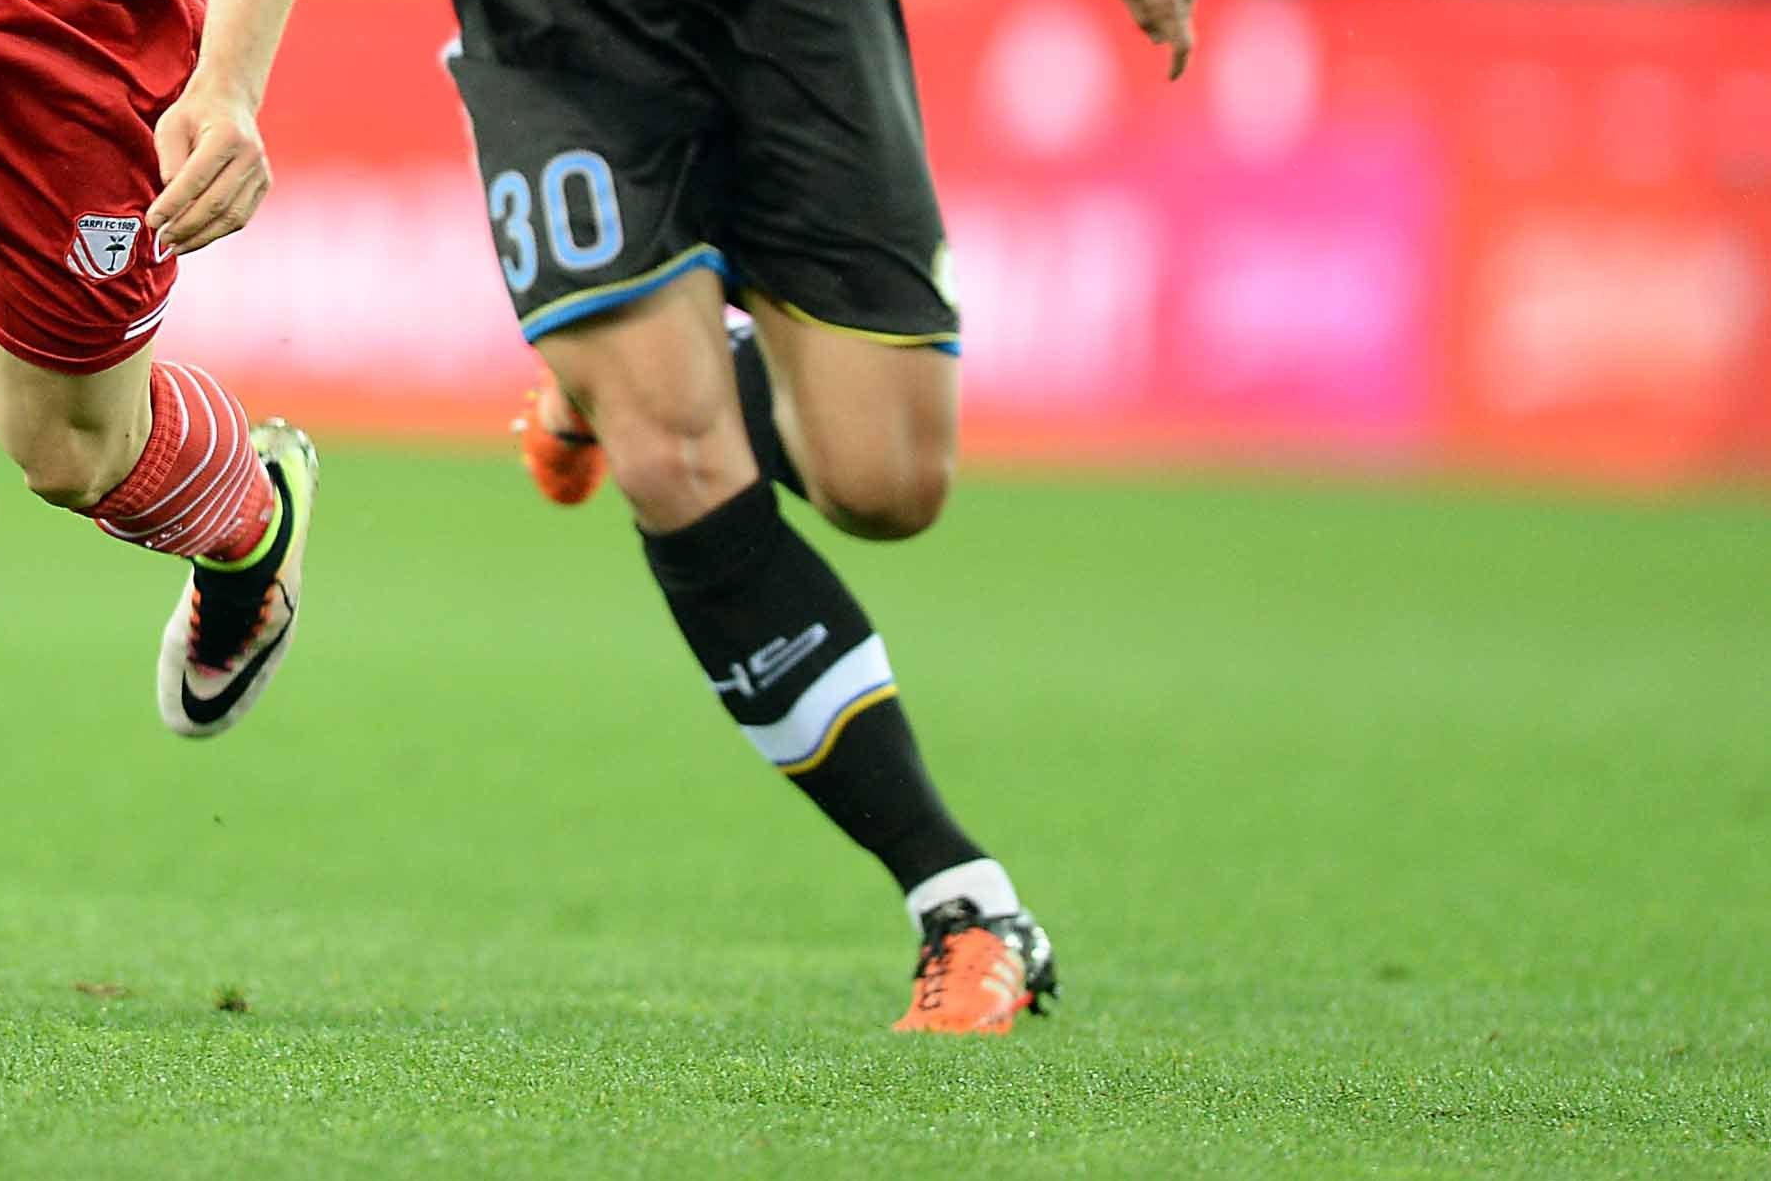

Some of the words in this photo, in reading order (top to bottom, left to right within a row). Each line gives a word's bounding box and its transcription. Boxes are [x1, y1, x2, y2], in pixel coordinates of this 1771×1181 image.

[78, 219, 104, 229] CARPI
[105, 220, 117, 229] FC
[488, 148, 625, 293] 30
